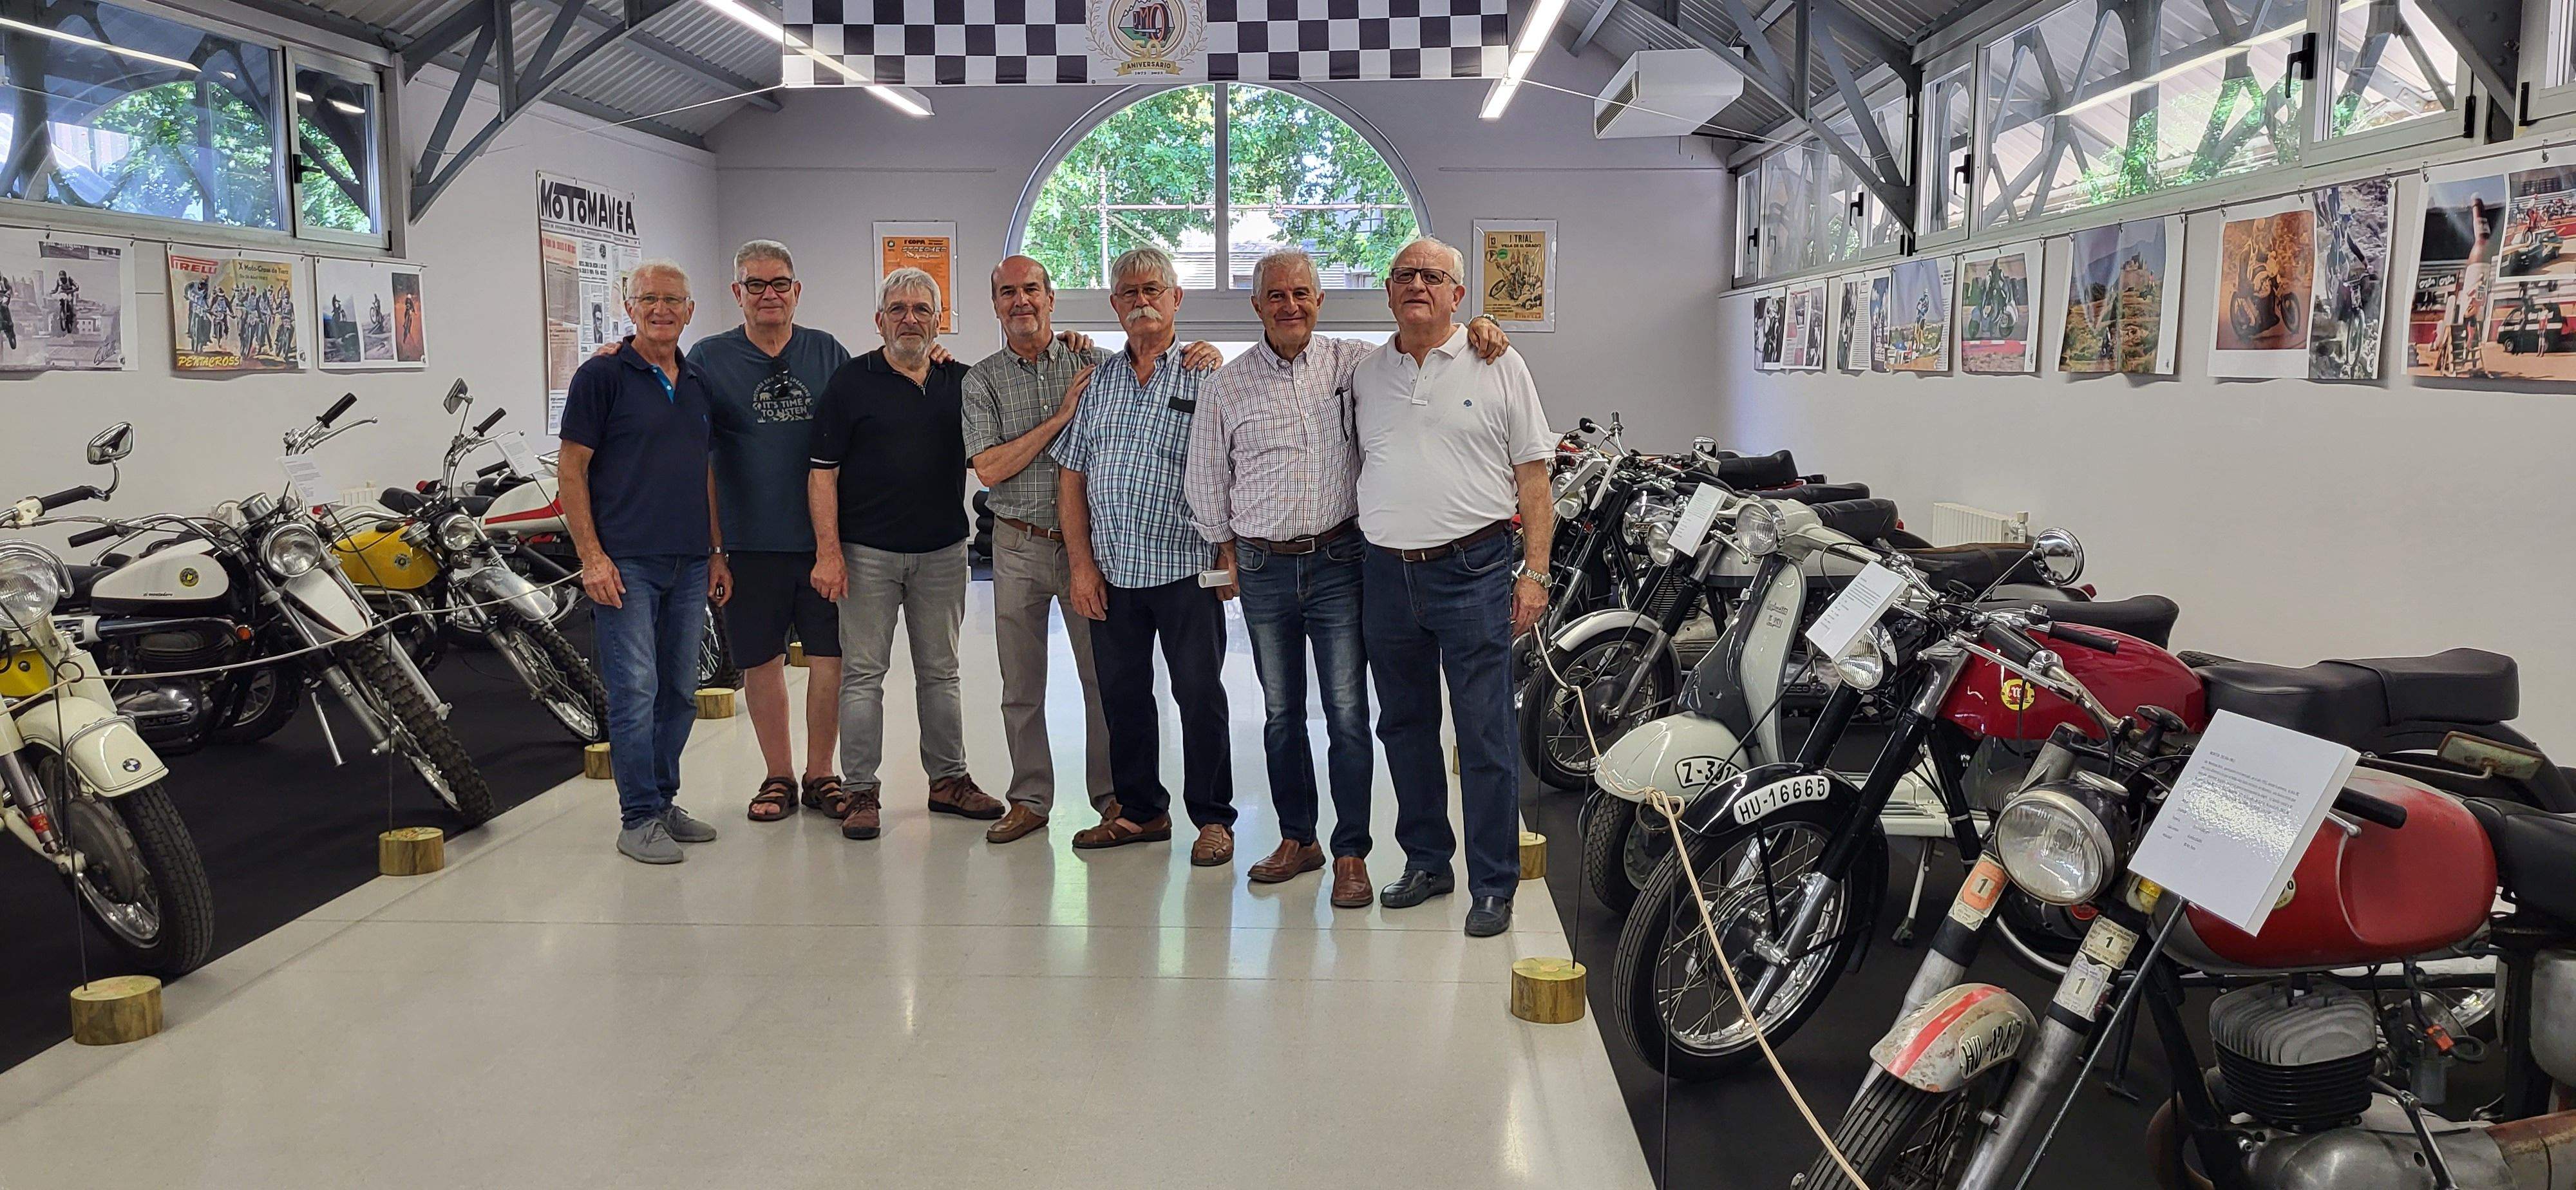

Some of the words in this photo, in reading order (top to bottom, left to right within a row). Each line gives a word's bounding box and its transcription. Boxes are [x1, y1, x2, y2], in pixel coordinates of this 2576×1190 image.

[1127, 61, 1171, 70] ANIVERSARIO
[1514, 234, 1533, 243] TRIAL
[171, 255, 218, 274] PIRELLI
[781, 399, 803, 408] TIME
[776, 406, 807, 416] LISTEN
[1739, 778, 1826, 822] HU-16665
[1977, 878, 1989, 894] 1
[2105, 936, 2114, 949] 1
[2075, 978, 2087, 994] 1
